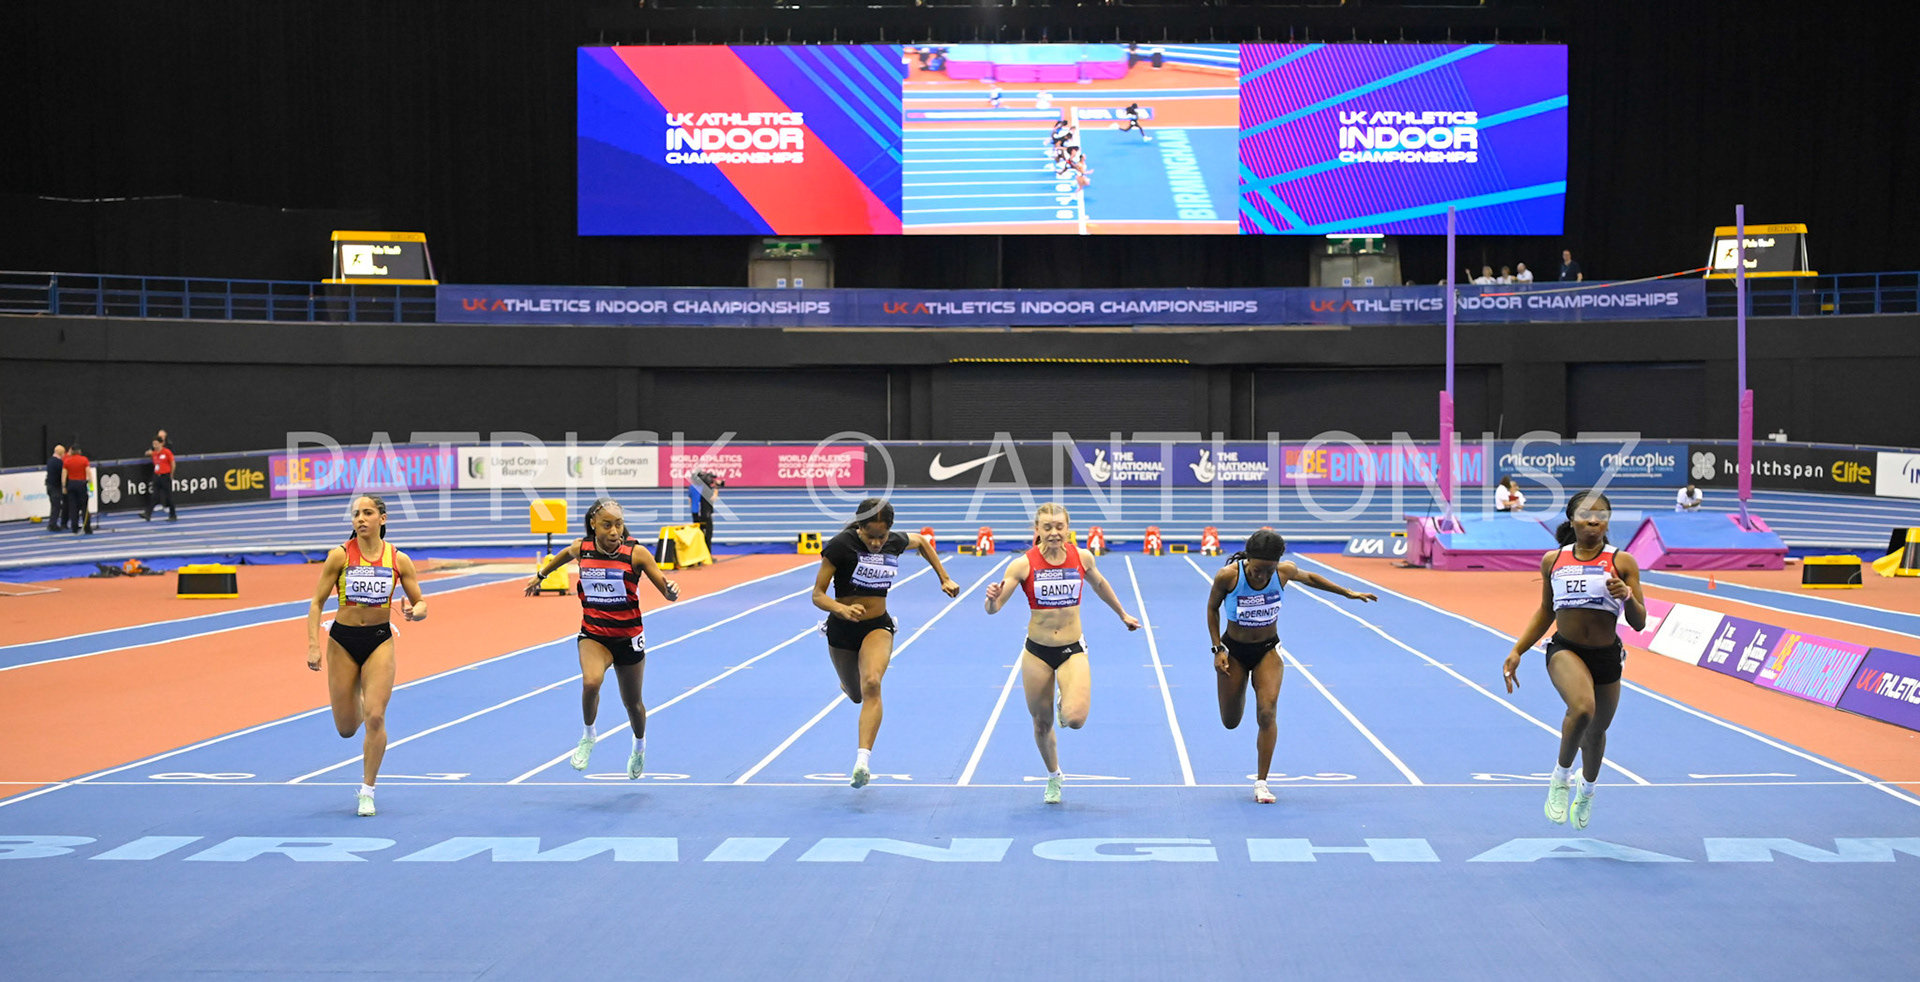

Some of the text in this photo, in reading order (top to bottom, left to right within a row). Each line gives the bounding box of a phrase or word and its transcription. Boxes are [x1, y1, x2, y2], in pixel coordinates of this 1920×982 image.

[666, 112, 804, 126] UK ATHLETICS
[1339, 111, 1478, 125] UK ATHLETICS
[666, 127, 804, 151] INDOOR
[1339, 126, 1478, 149] INDOOR
[665, 151, 804, 164] CHAMPIONSHIPS
[1338, 150, 1478, 163] CHAMPIONSHIPS
[462, 298, 831, 315] UK ATHLETICS INDOOR CHAMPIONSHIPS
[883, 300, 1258, 315] UK ATHLETICS INDOOR CHAMPIONSHIPS
[1310, 292, 1679, 312] UK ATHLETICS NDOOR CHAMPIONSHIPS
[517, 456, 549, 466] Cowan
[589, 456, 649, 467] Lloyd Cowan
[777, 454, 808, 463] WORLD
[1112, 451, 1134, 462] THE
[1217, 451, 1239, 462] THE
[314, 454, 455, 491] BIRMINGHAM
[501, 466, 538, 478] Bursary
[601, 466, 638, 478] Bursary
[1112, 461, 1165, 472] NATIONAL
[1217, 461, 1270, 472] NATIONAL
[1831, 460, 1872, 484] Elite
[728, 468, 743, 479] 24
[777, 468, 851, 479] GLASGOW 24
[1112, 471, 1161, 481] LOTTERY
[1217, 471, 1264, 481] LOTTERY
[127, 476, 218, 496] heahspan
[224, 468, 265, 491] Elite
[1090, 535, 1101, 550] 4
[1148, 534, 1159, 550] 3
[1204, 535, 1216, 549] 2
[1349, 538, 1384, 554] UKA
[351, 581, 387, 593] GRACE
[1041, 584, 1076, 597] BANDY
[1565, 579, 1587, 594] EZE
[1238, 605, 1280, 619] ADERINTO
[637, 635, 645, 649] 6
[1856, 667, 1879, 691] UK
[148, 772, 256, 780] 8
[1246, 772, 1357, 782] 3
